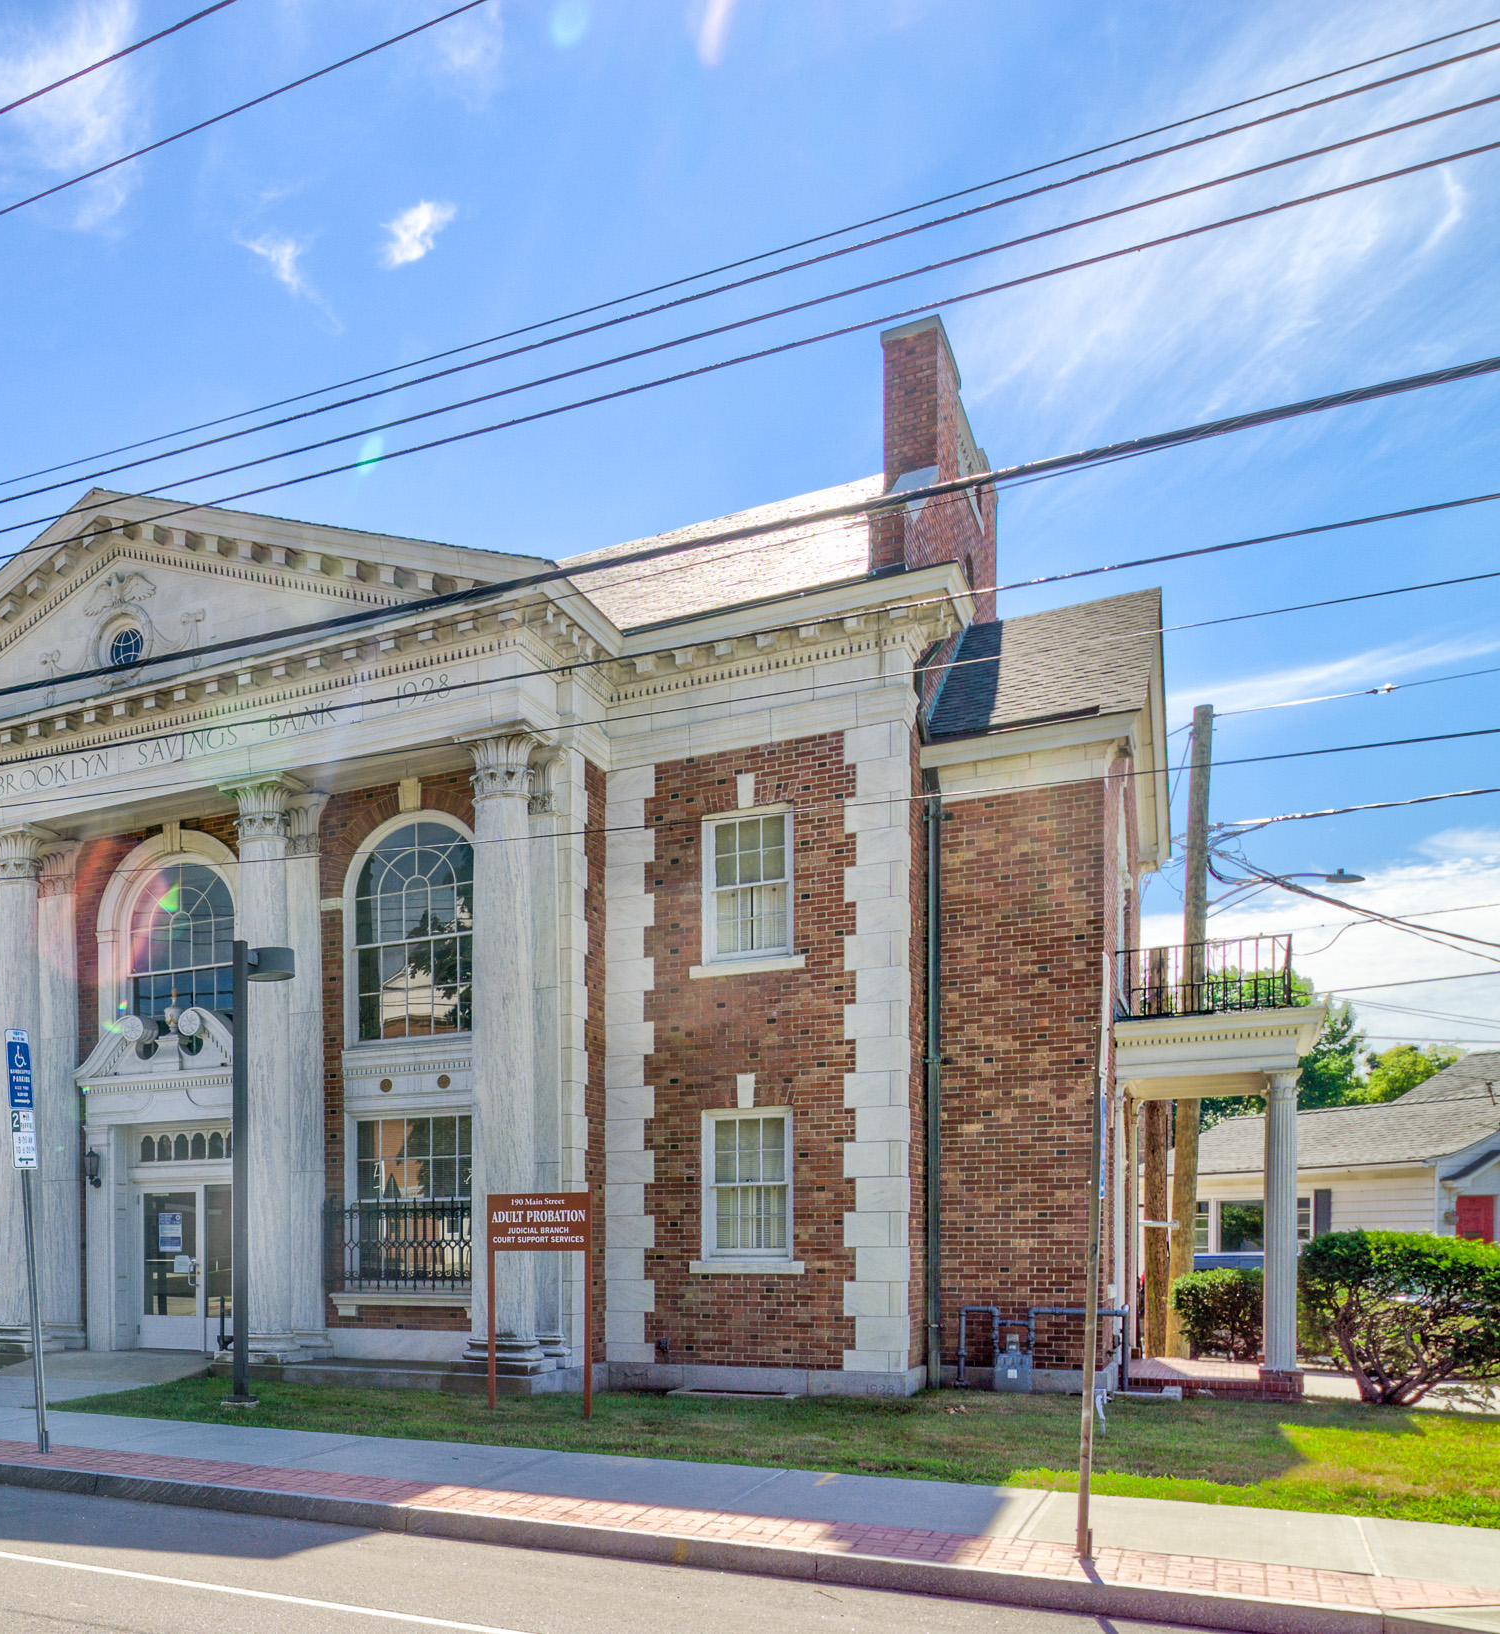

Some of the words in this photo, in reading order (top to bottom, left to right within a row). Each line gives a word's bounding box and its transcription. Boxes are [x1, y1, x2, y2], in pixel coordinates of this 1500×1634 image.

[137, 725, 238, 766] SAVINGS
[268, 701, 337, 737] BANK
[395, 673, 451, 709] 1928
[12, 1112, 20, 1128] 2
[511, 1198, 524, 1206] 190
[544, 1197, 565, 1205] Street
[491, 1210, 524, 1223] ADULT
[526, 1209, 586, 1222] PROBATION
[540, 1226, 569, 1234] BRANCH
[517, 1235, 549, 1243] SUPPORT
[550, 1235, 585, 1243] SERVICES
[866, 1384, 895, 1396] 1928
